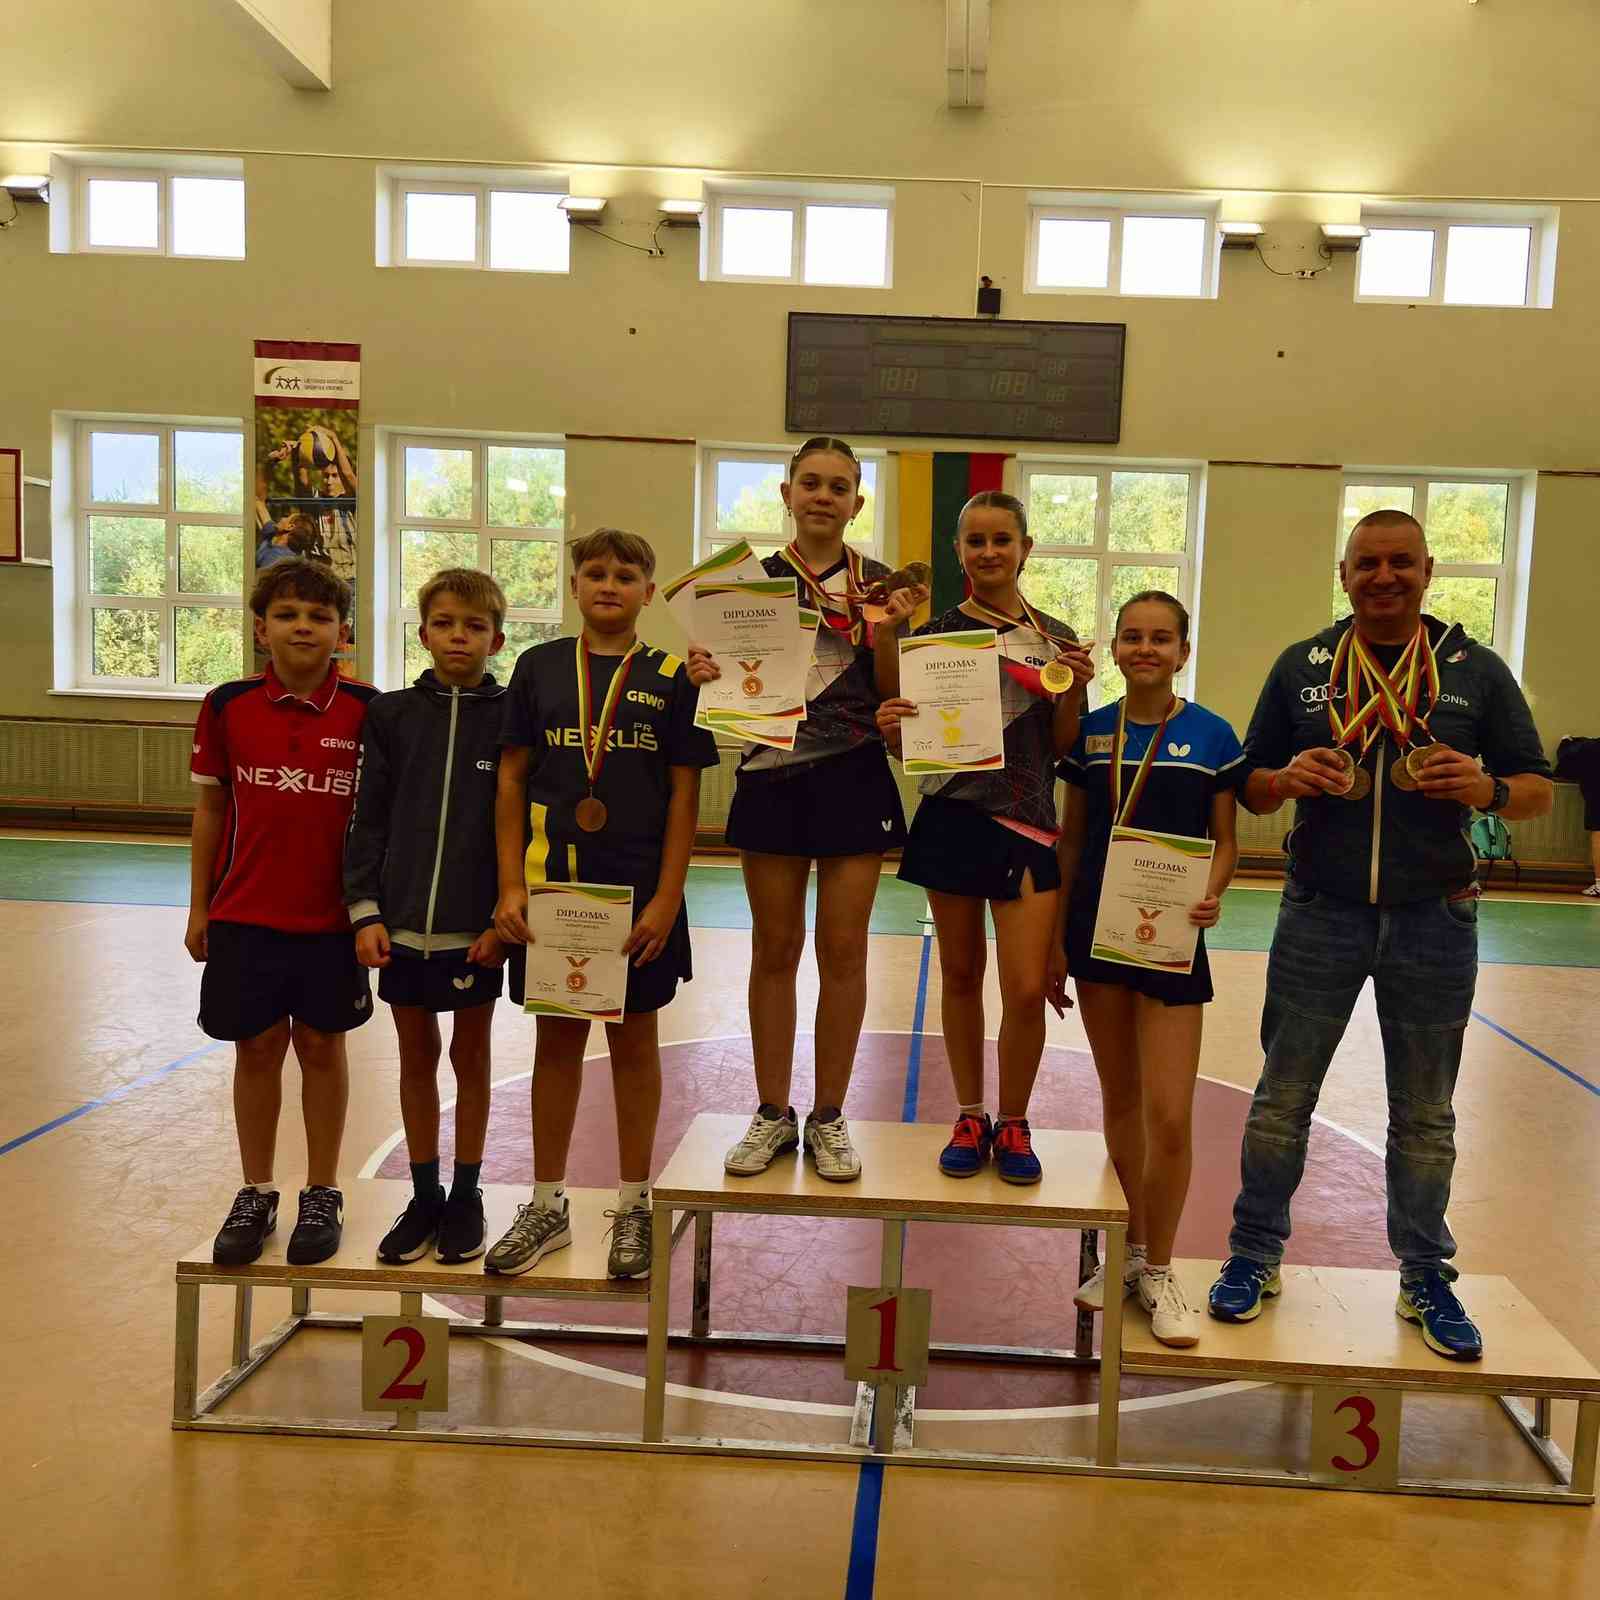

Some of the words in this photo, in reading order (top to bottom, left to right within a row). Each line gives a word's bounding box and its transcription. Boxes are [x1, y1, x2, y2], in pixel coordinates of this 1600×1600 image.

[723, 609, 776, 619] DIPLOMAS
[926, 659, 976, 670] DIPLOMAS
[1025, 656, 1047, 666] GEW
[626, 690, 665, 710] GEWO
[320, 738, 356, 750] GEWO
[327, 768, 353, 778] PRO
[236, 766, 351, 796] NEXUS
[1134, 859, 1187, 872] DIPLOMAS
[557, 909, 610, 919] DIPLOMAS
[867, 1297, 904, 1373] 1
[379, 1327, 428, 1400] 2
[1331, 1396, 1380, 1471] 3
